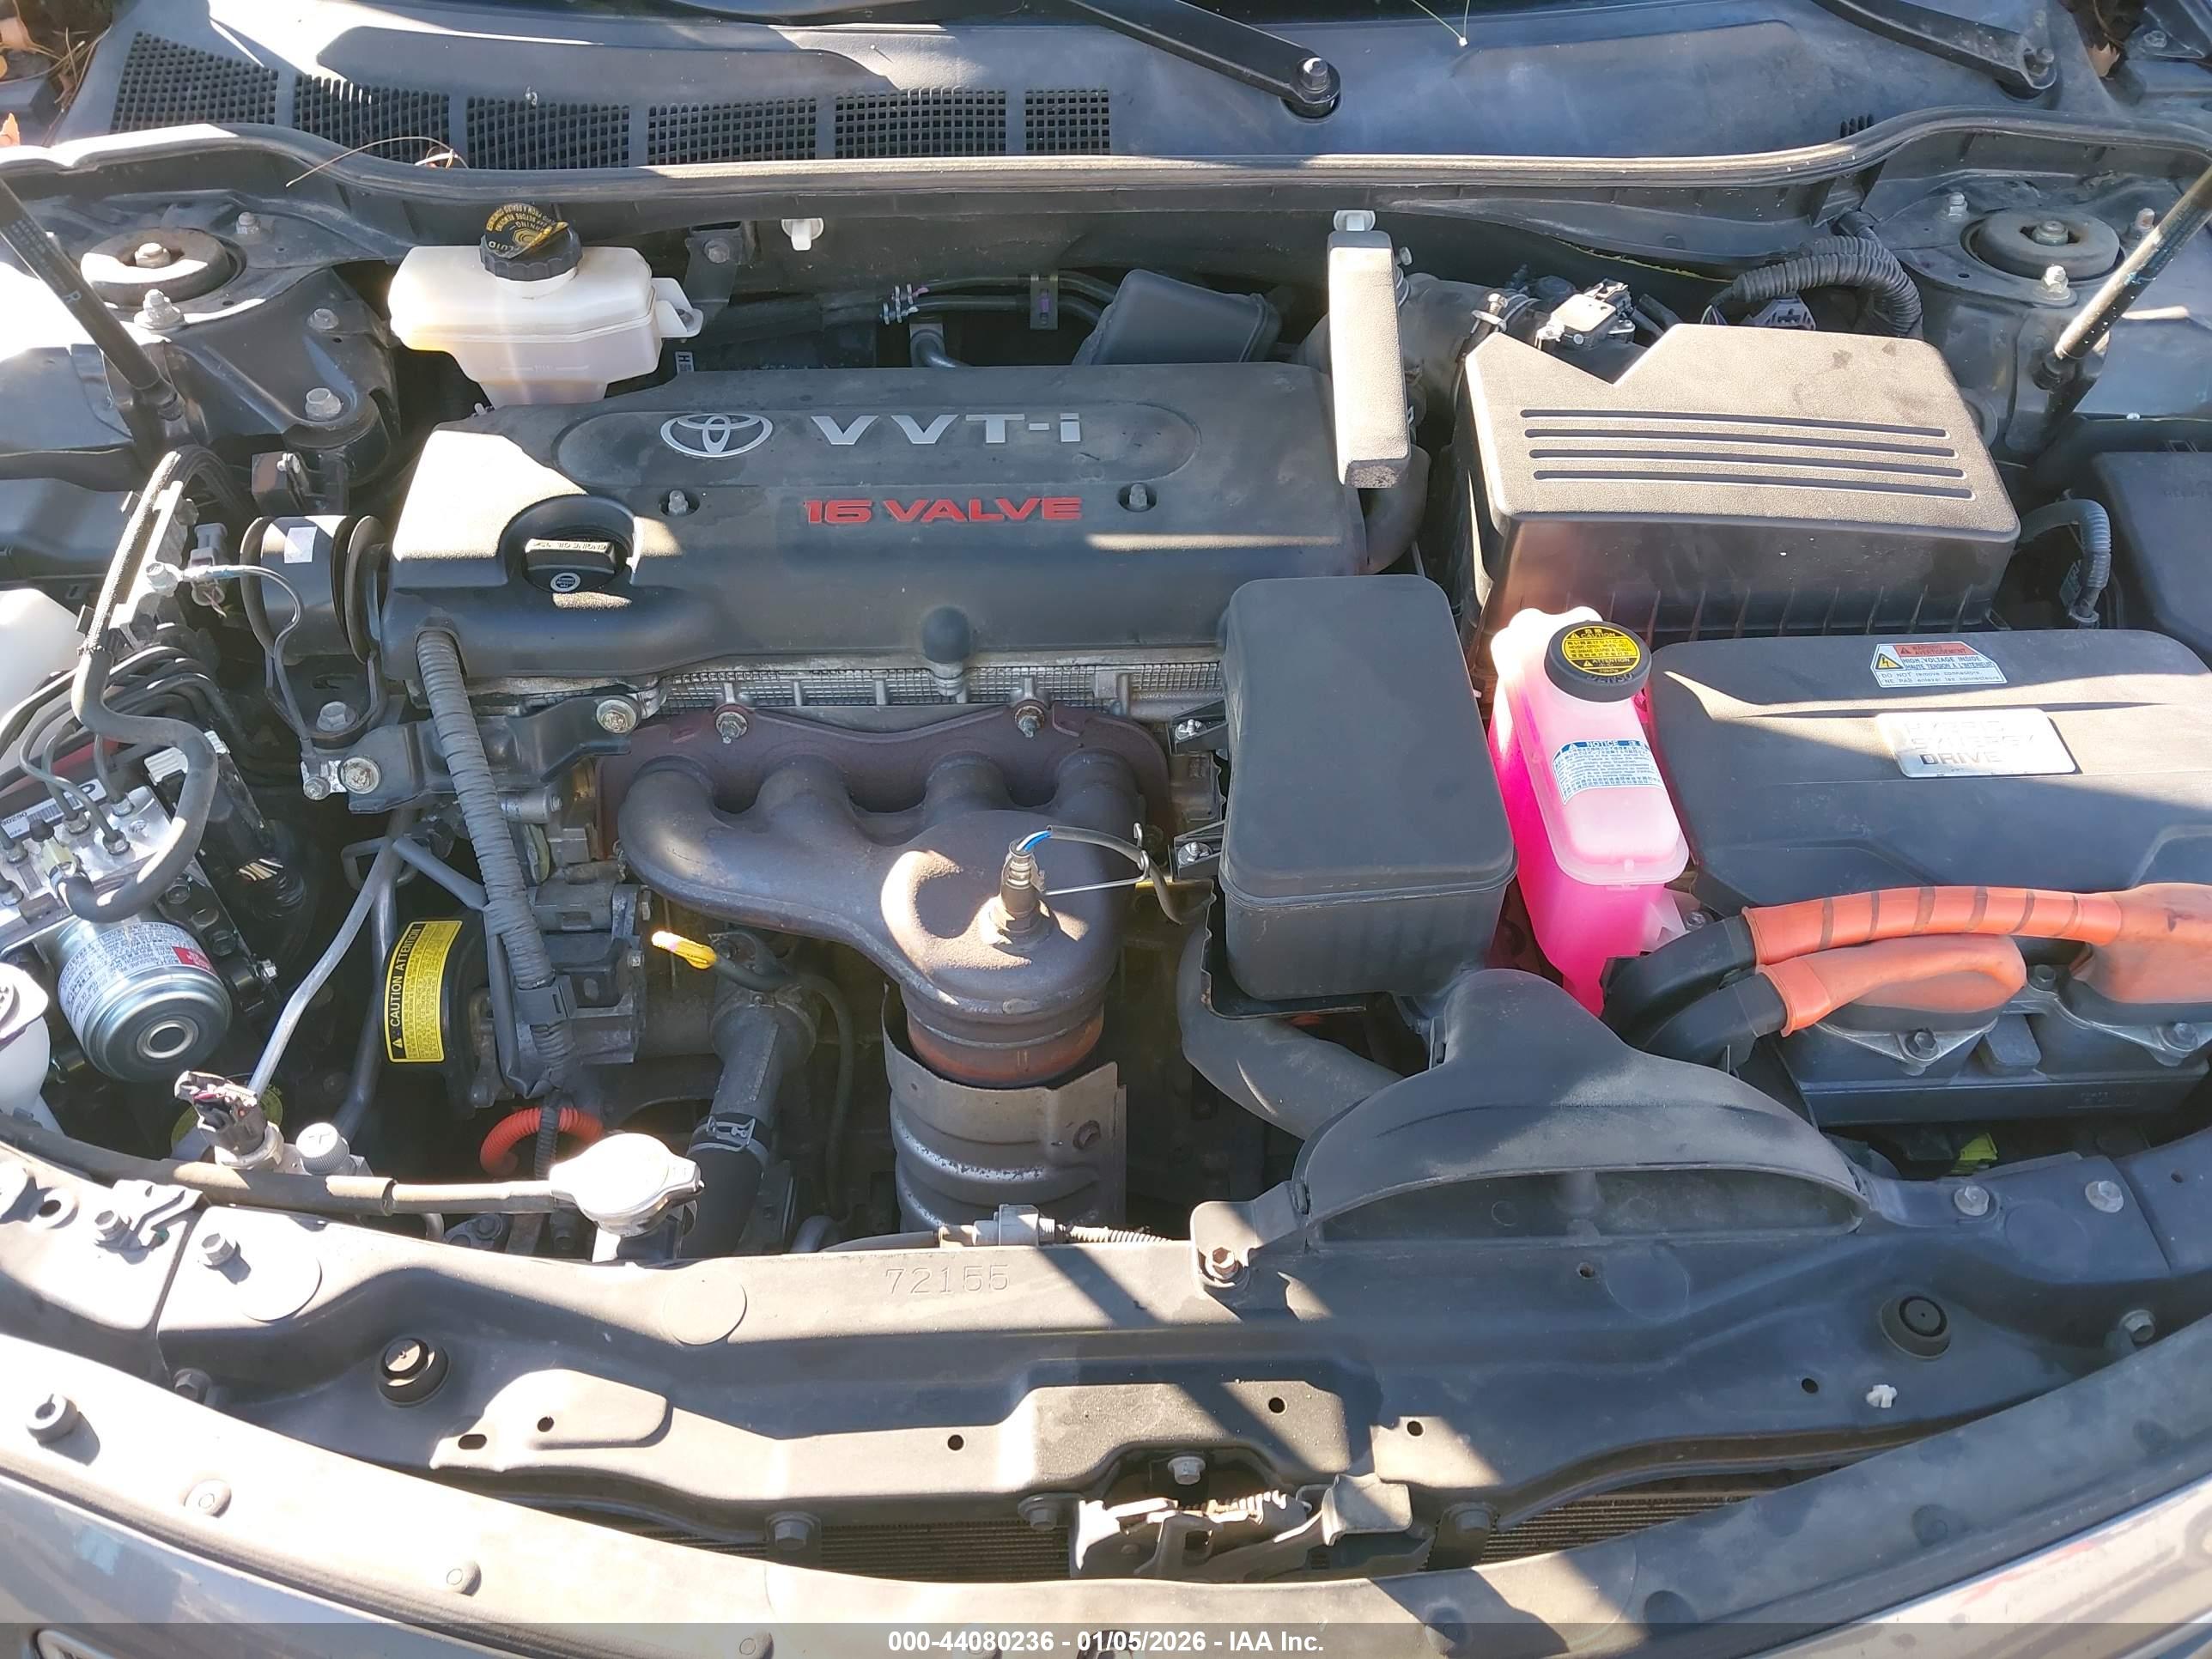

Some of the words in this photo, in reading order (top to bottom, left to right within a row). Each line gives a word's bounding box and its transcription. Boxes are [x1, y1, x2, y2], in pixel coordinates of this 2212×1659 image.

[810, 412, 1082, 446] VVT-i
[804, 499, 873, 524] 16
[883, 496, 1082, 523] VALVE
[1919, 751, 2003, 765] DRIVE
[395, 927, 422, 971] ATTENTION
[390, 975, 404, 1028] CAUTION
[885, 1264, 1011, 1295] 72155
